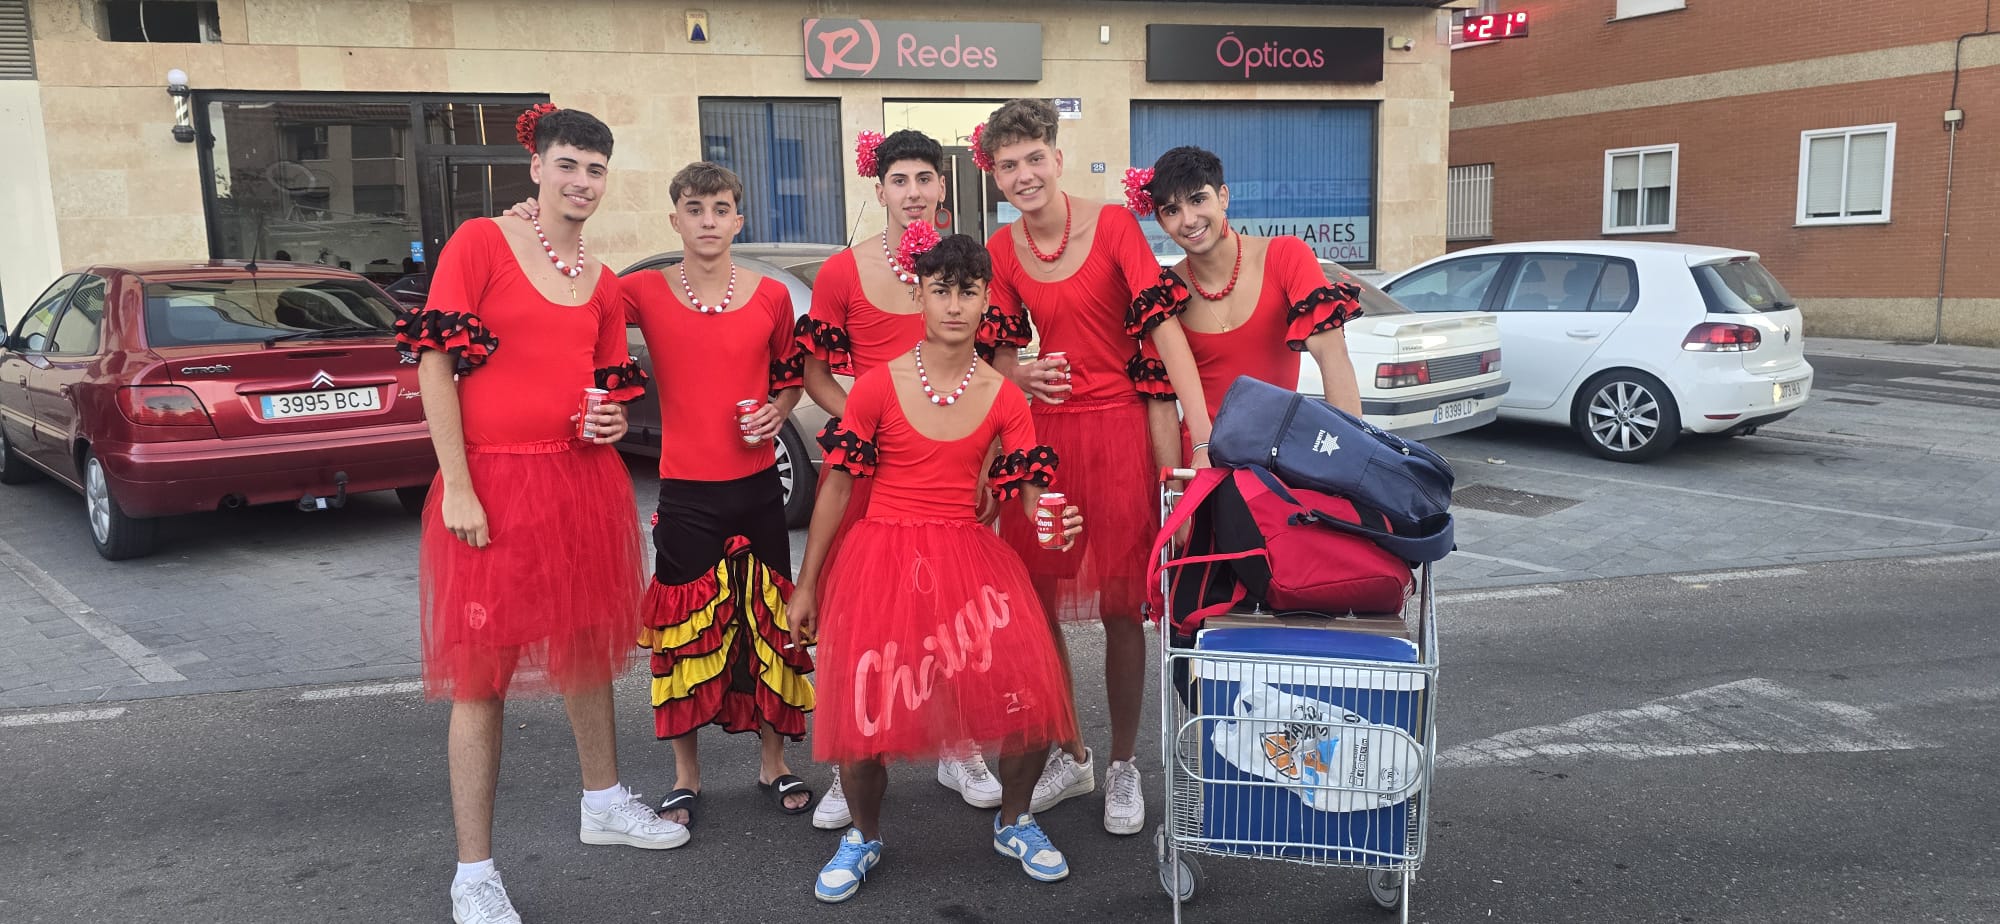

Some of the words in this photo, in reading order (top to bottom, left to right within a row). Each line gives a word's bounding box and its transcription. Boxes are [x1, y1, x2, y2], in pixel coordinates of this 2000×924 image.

[897, 32, 999, 69] Redes
[1216, 31, 1325, 79] Ópticas
[1092, 163, 1105, 173] 28
[1322, 246, 1365, 260] LOCAL
[279, 394, 330, 415] 3995
[335, 390, 374, 410] BCJ
[1444, 402, 1462, 419] 8399
[1463, 400, 1472, 416] LD
